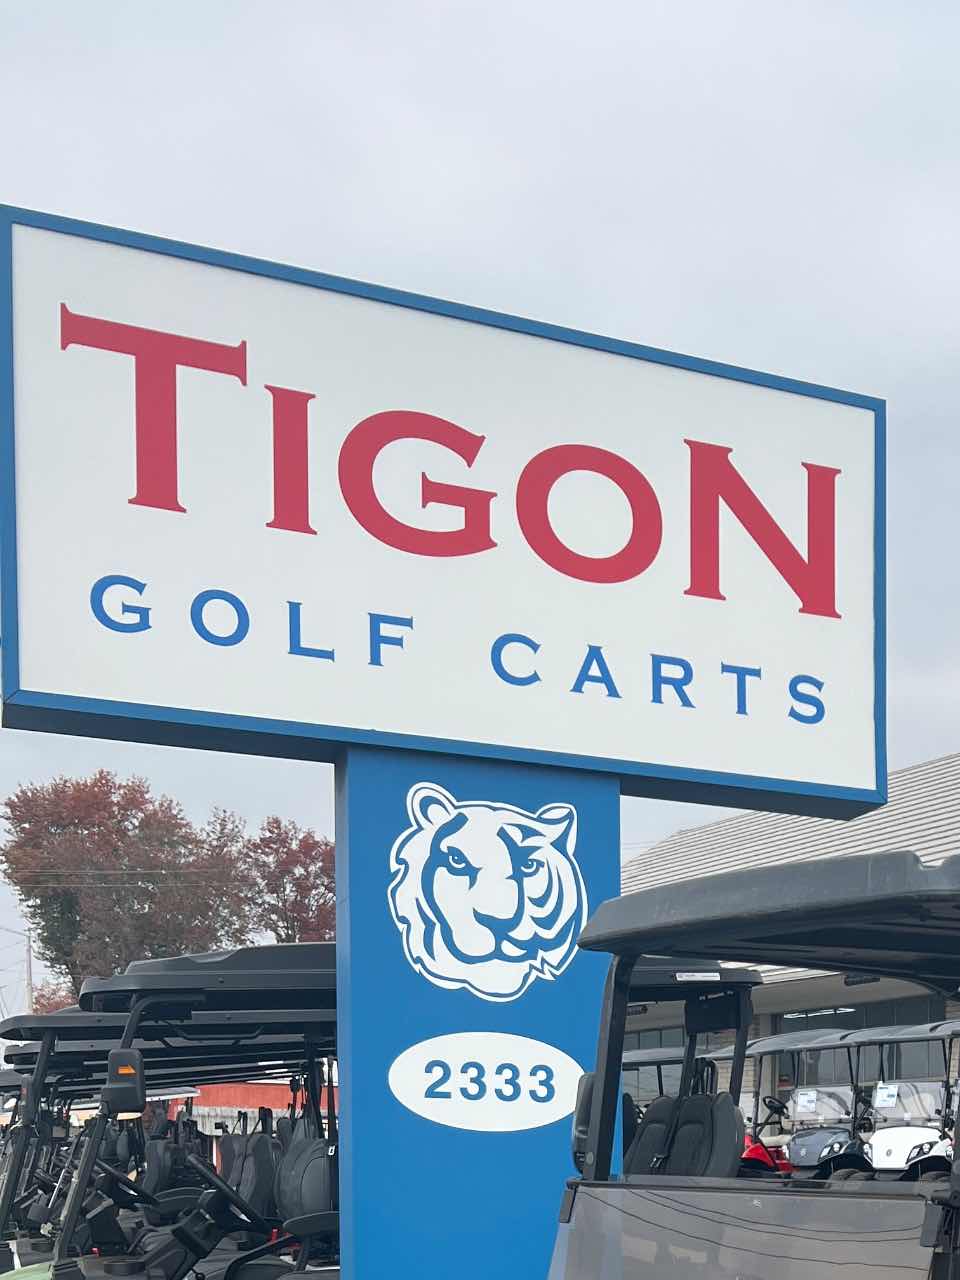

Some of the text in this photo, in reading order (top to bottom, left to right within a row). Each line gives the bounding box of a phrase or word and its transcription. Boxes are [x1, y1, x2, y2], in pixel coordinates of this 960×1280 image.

[60, 303, 841, 620] TIGON
[89, 575, 826, 725] GOLF CARTS
[424, 1059, 556, 1103] 2333
